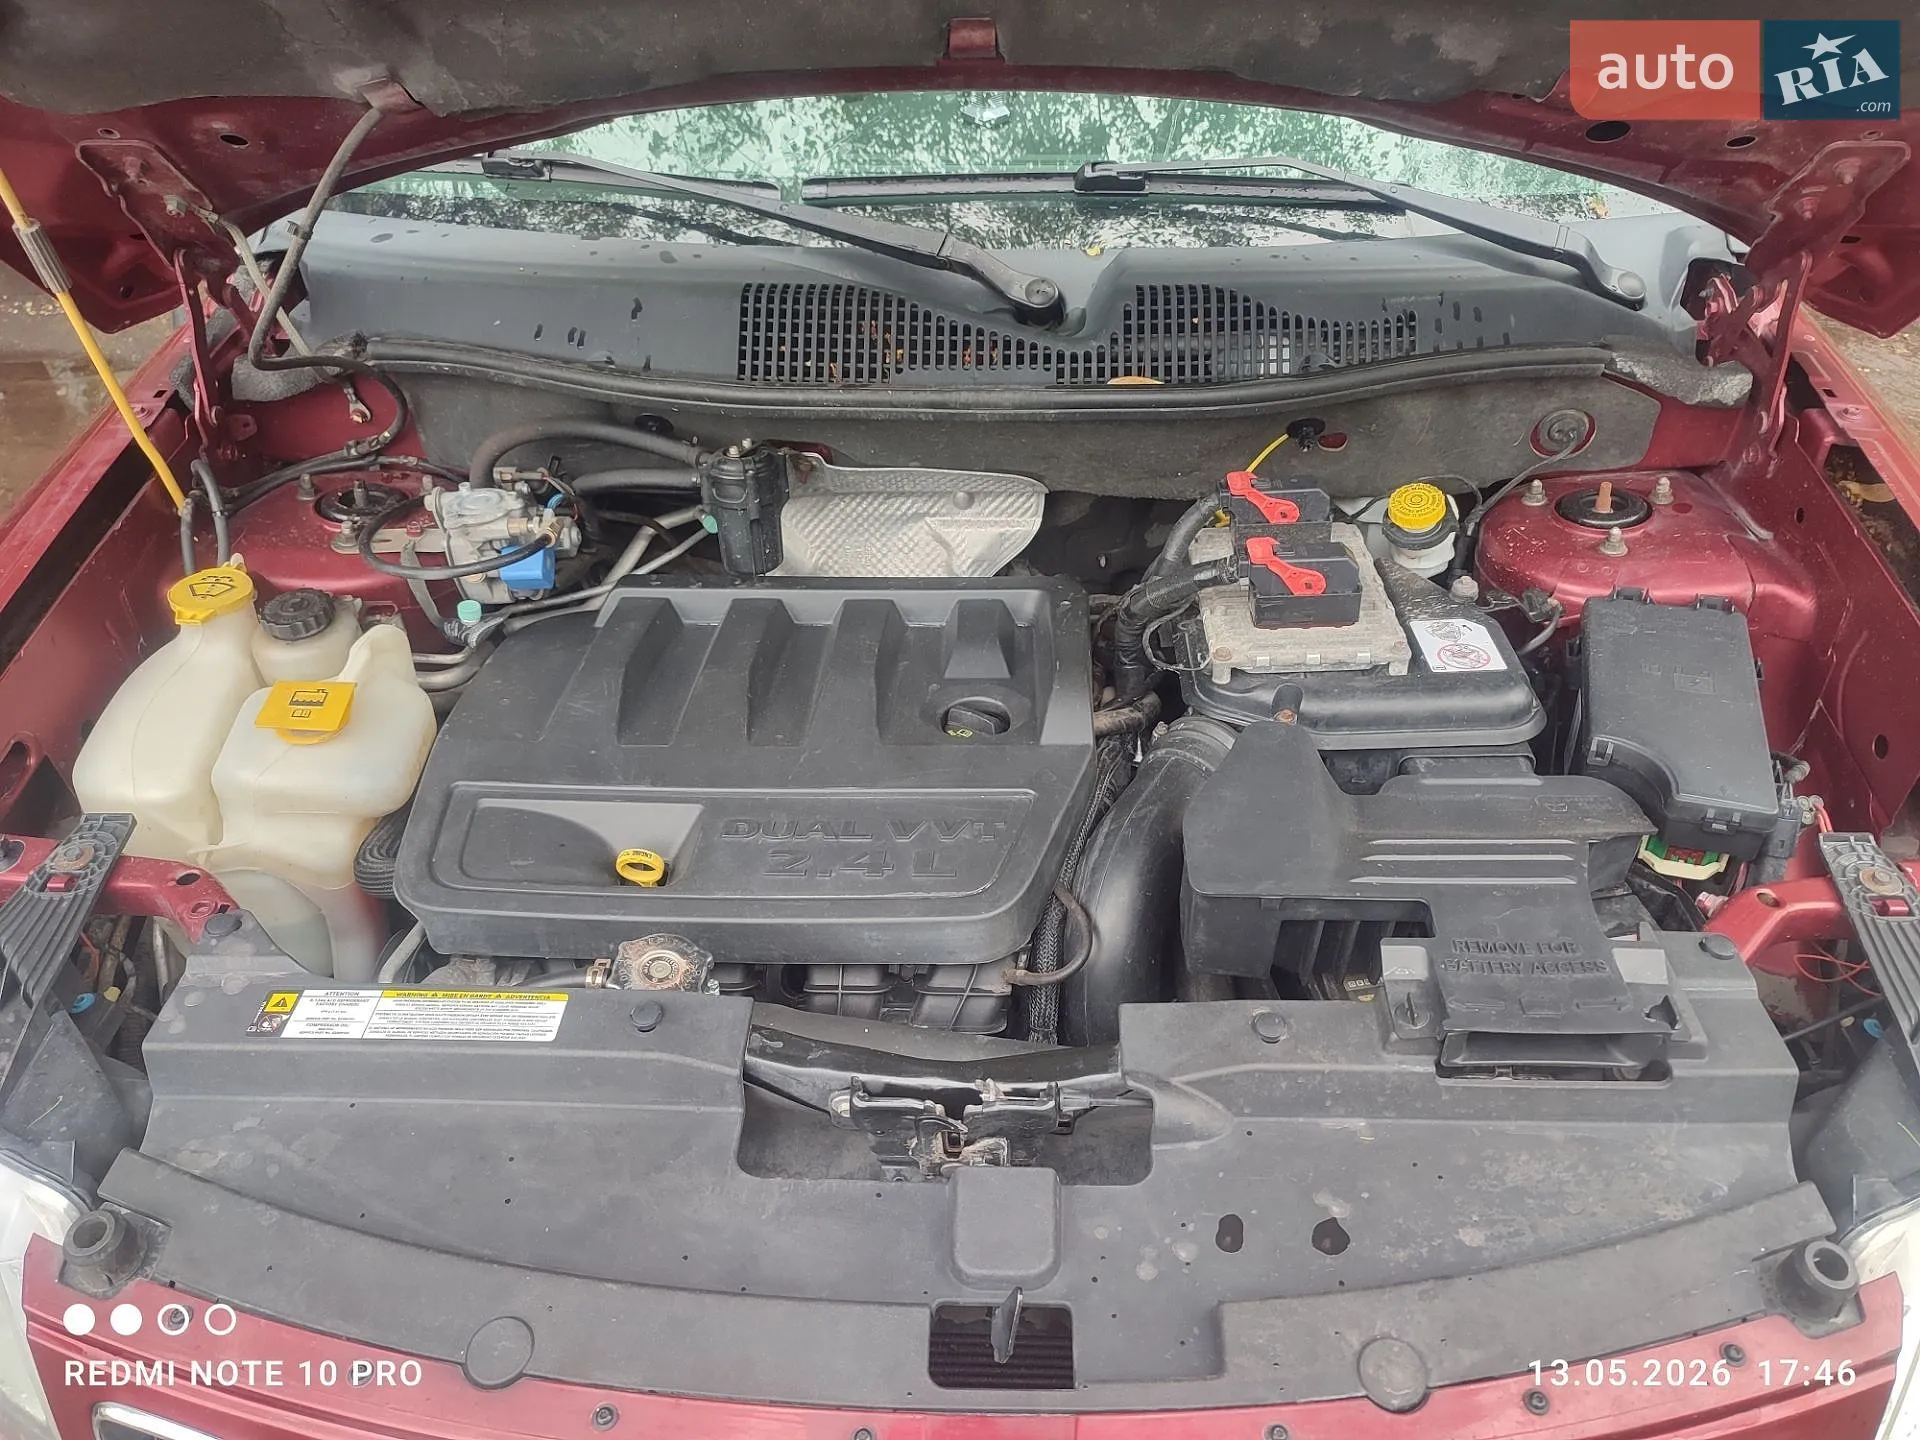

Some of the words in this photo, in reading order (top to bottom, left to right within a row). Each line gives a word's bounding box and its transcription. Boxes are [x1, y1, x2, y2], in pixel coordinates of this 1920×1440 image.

[721, 818, 872, 840] DUAL
[887, 820, 1007, 841] VVT
[1451, 938, 1534, 955] REMOVE
[1537, 940, 1577, 955] FOR
[1443, 958, 1524, 975] BATTERY
[1529, 959, 1609, 975] ACCESS
